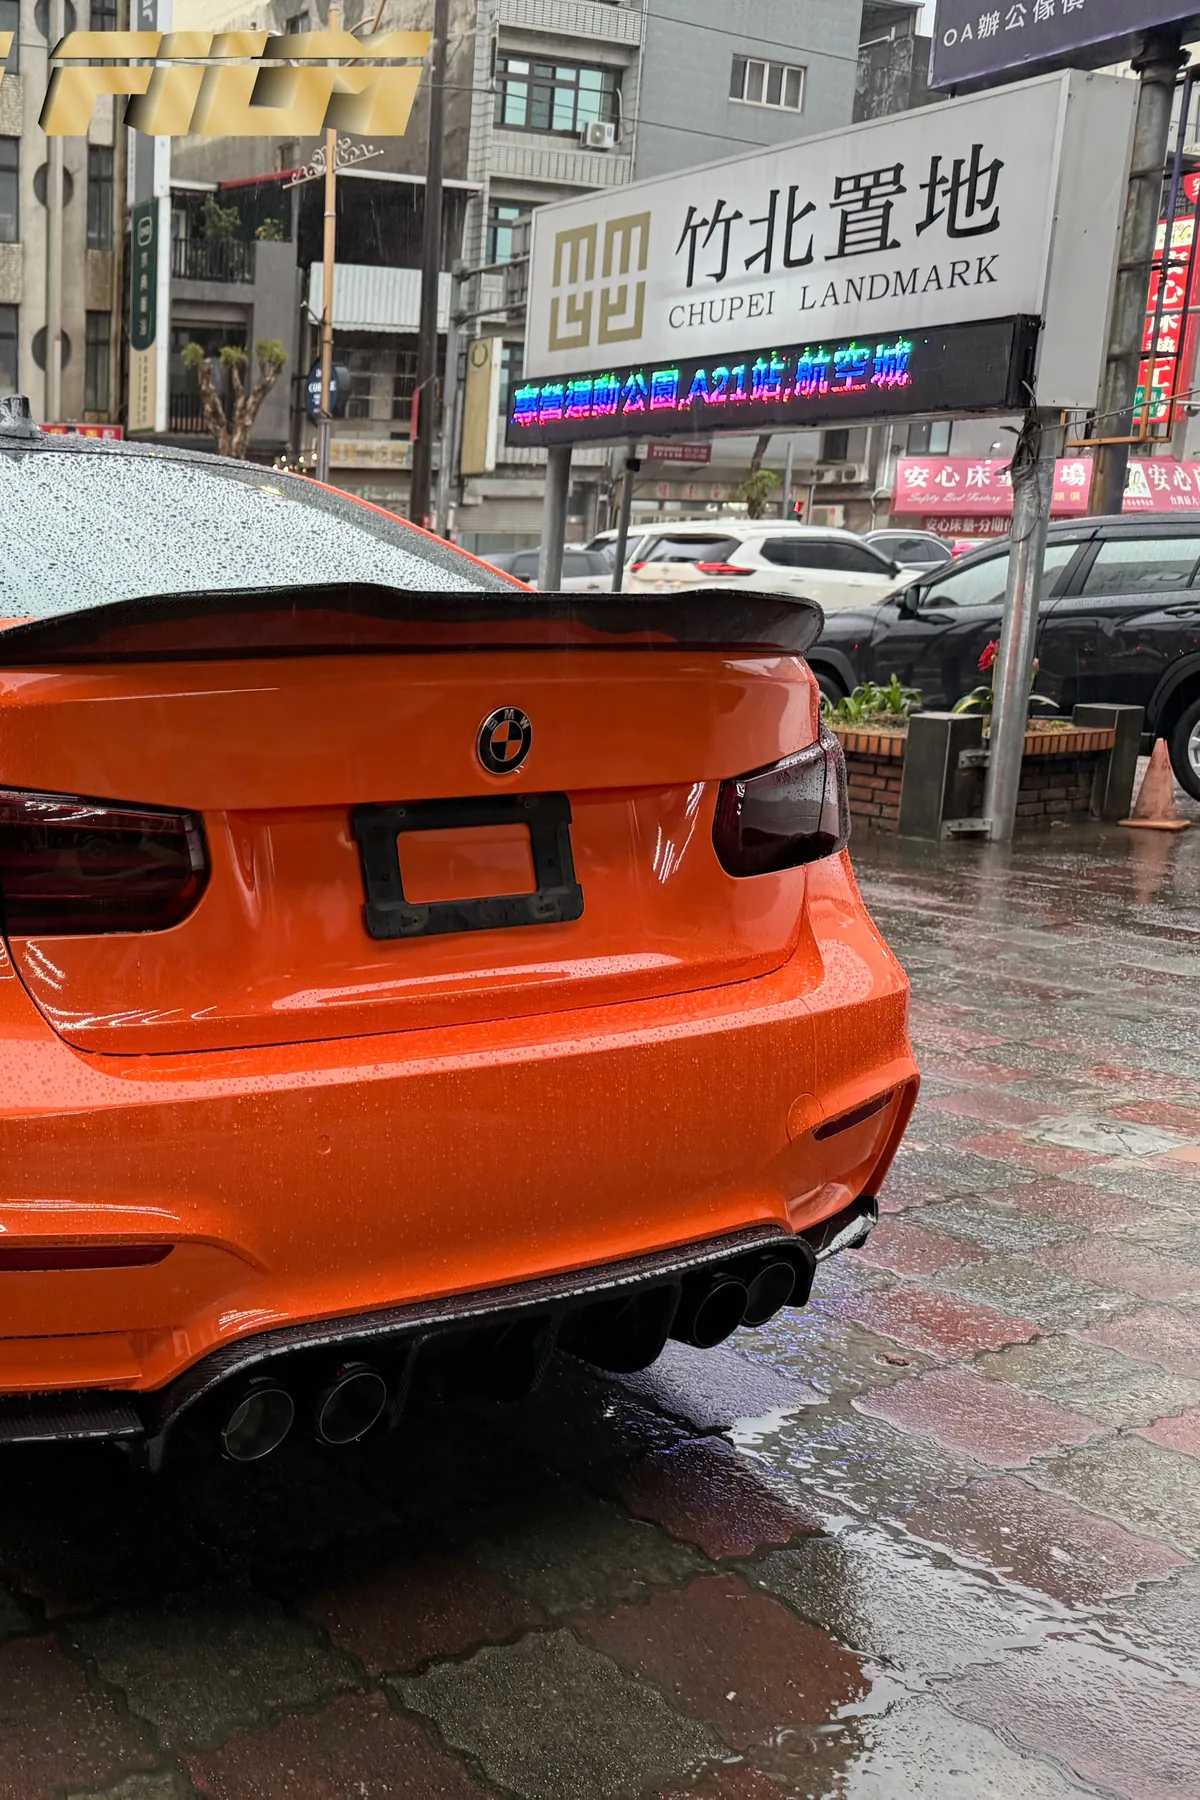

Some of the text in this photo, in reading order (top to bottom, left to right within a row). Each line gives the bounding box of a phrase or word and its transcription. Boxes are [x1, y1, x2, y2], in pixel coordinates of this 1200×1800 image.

[675, 144, 1004, 287] 竹北置地
[668, 254, 999, 329] CHUPEI LANDMARK
[903, 462, 1086, 488] 安心床場
[486, 708, 530, 731] BMW
